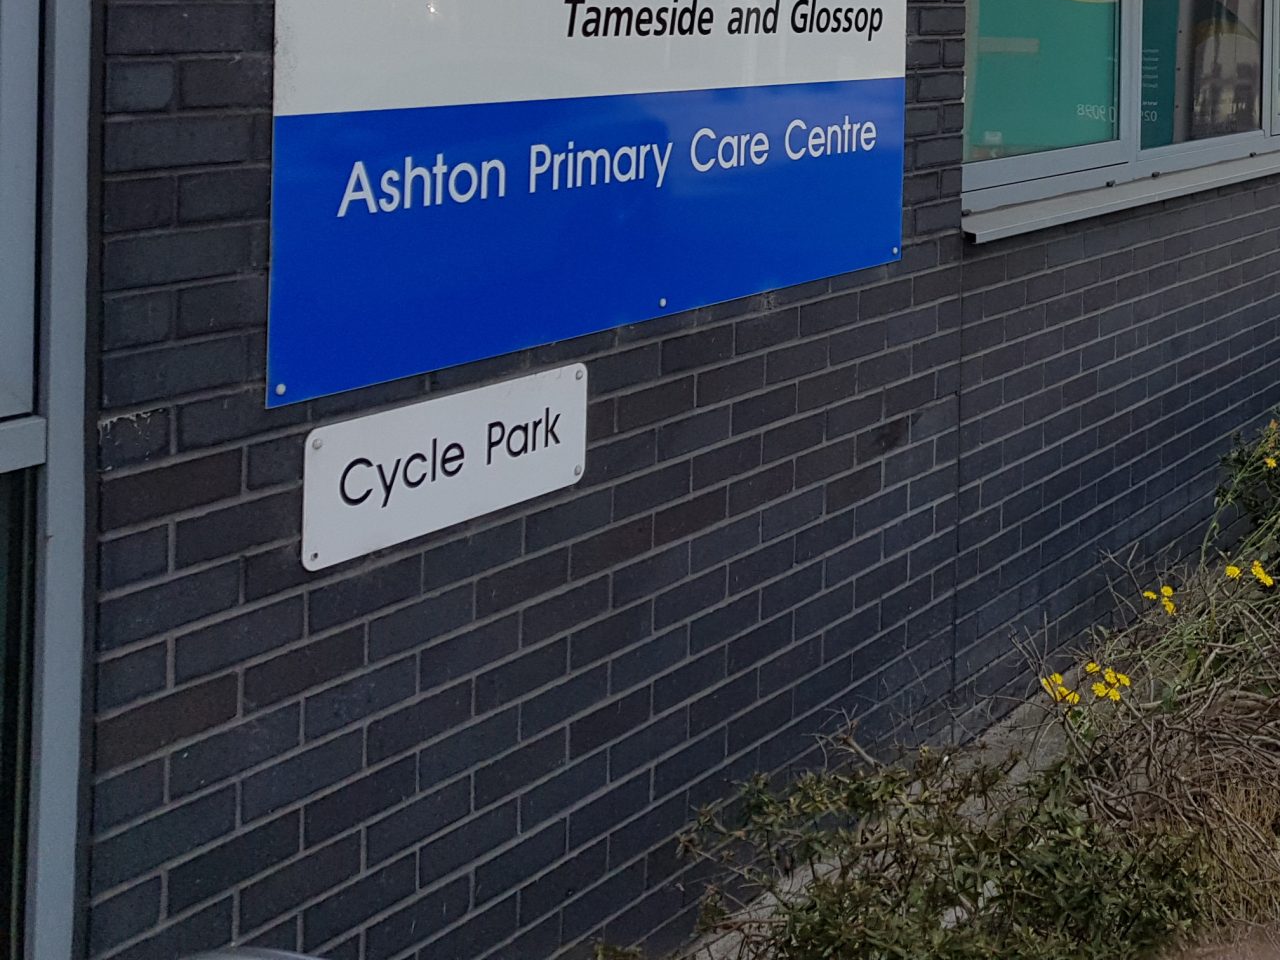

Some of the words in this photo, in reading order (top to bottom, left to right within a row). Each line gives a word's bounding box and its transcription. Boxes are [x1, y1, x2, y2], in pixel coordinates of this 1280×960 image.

[337, 154, 506, 218] Ashton
[529, 137, 674, 194] Primary
[690, 126, 770, 174] Care
[784, 115, 878, 161] Centre
[340, 436, 466, 508] Cycle
[486, 406, 563, 466] Park
